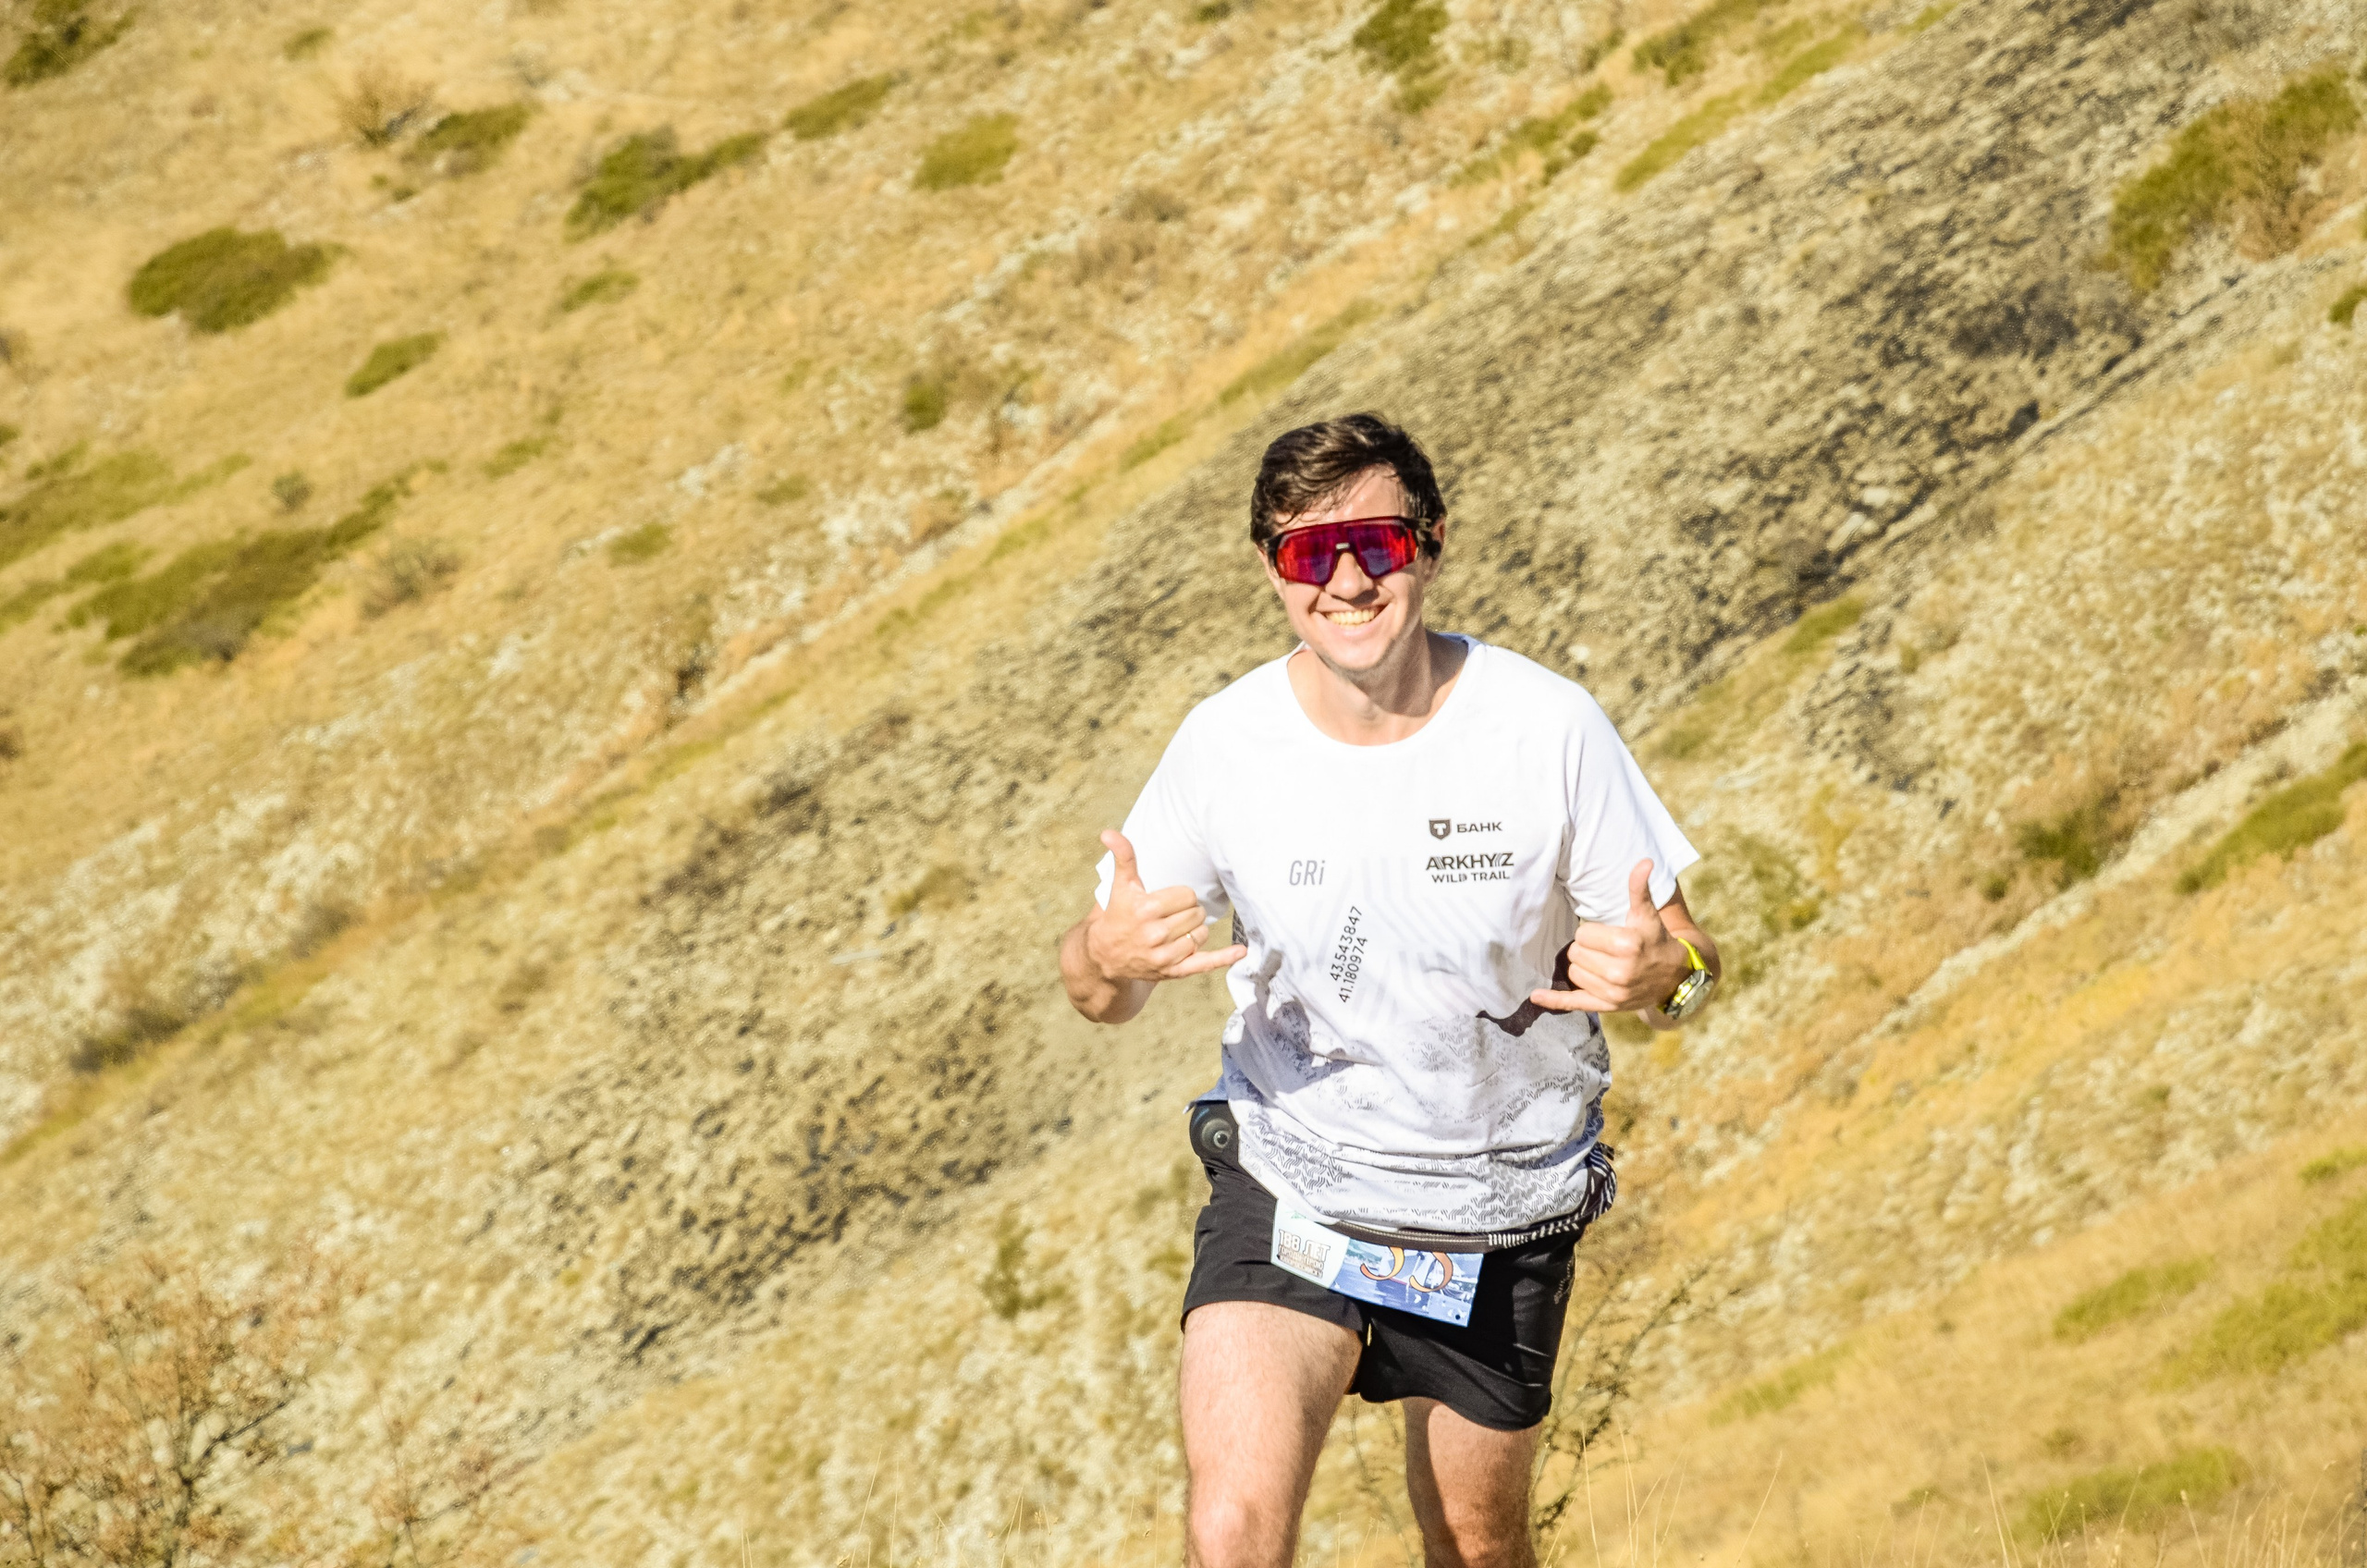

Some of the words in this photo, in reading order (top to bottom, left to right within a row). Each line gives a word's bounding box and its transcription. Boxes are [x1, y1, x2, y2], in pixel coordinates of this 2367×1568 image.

[1456, 821, 1502, 833] БАНК
[1289, 860, 1325, 886] GRi
[1426, 852, 1515, 870] ARKHYZ
[1431, 873, 1467, 883] WILD
[1471, 870, 1510, 882] TRAIL
[1330, 906, 1362, 981] 43.543847
[1339, 937, 1367, 1003] 41.180974
[1279, 1229, 1301, 1252] 188
[1303, 1240, 1331, 1262] ЛЕТ
